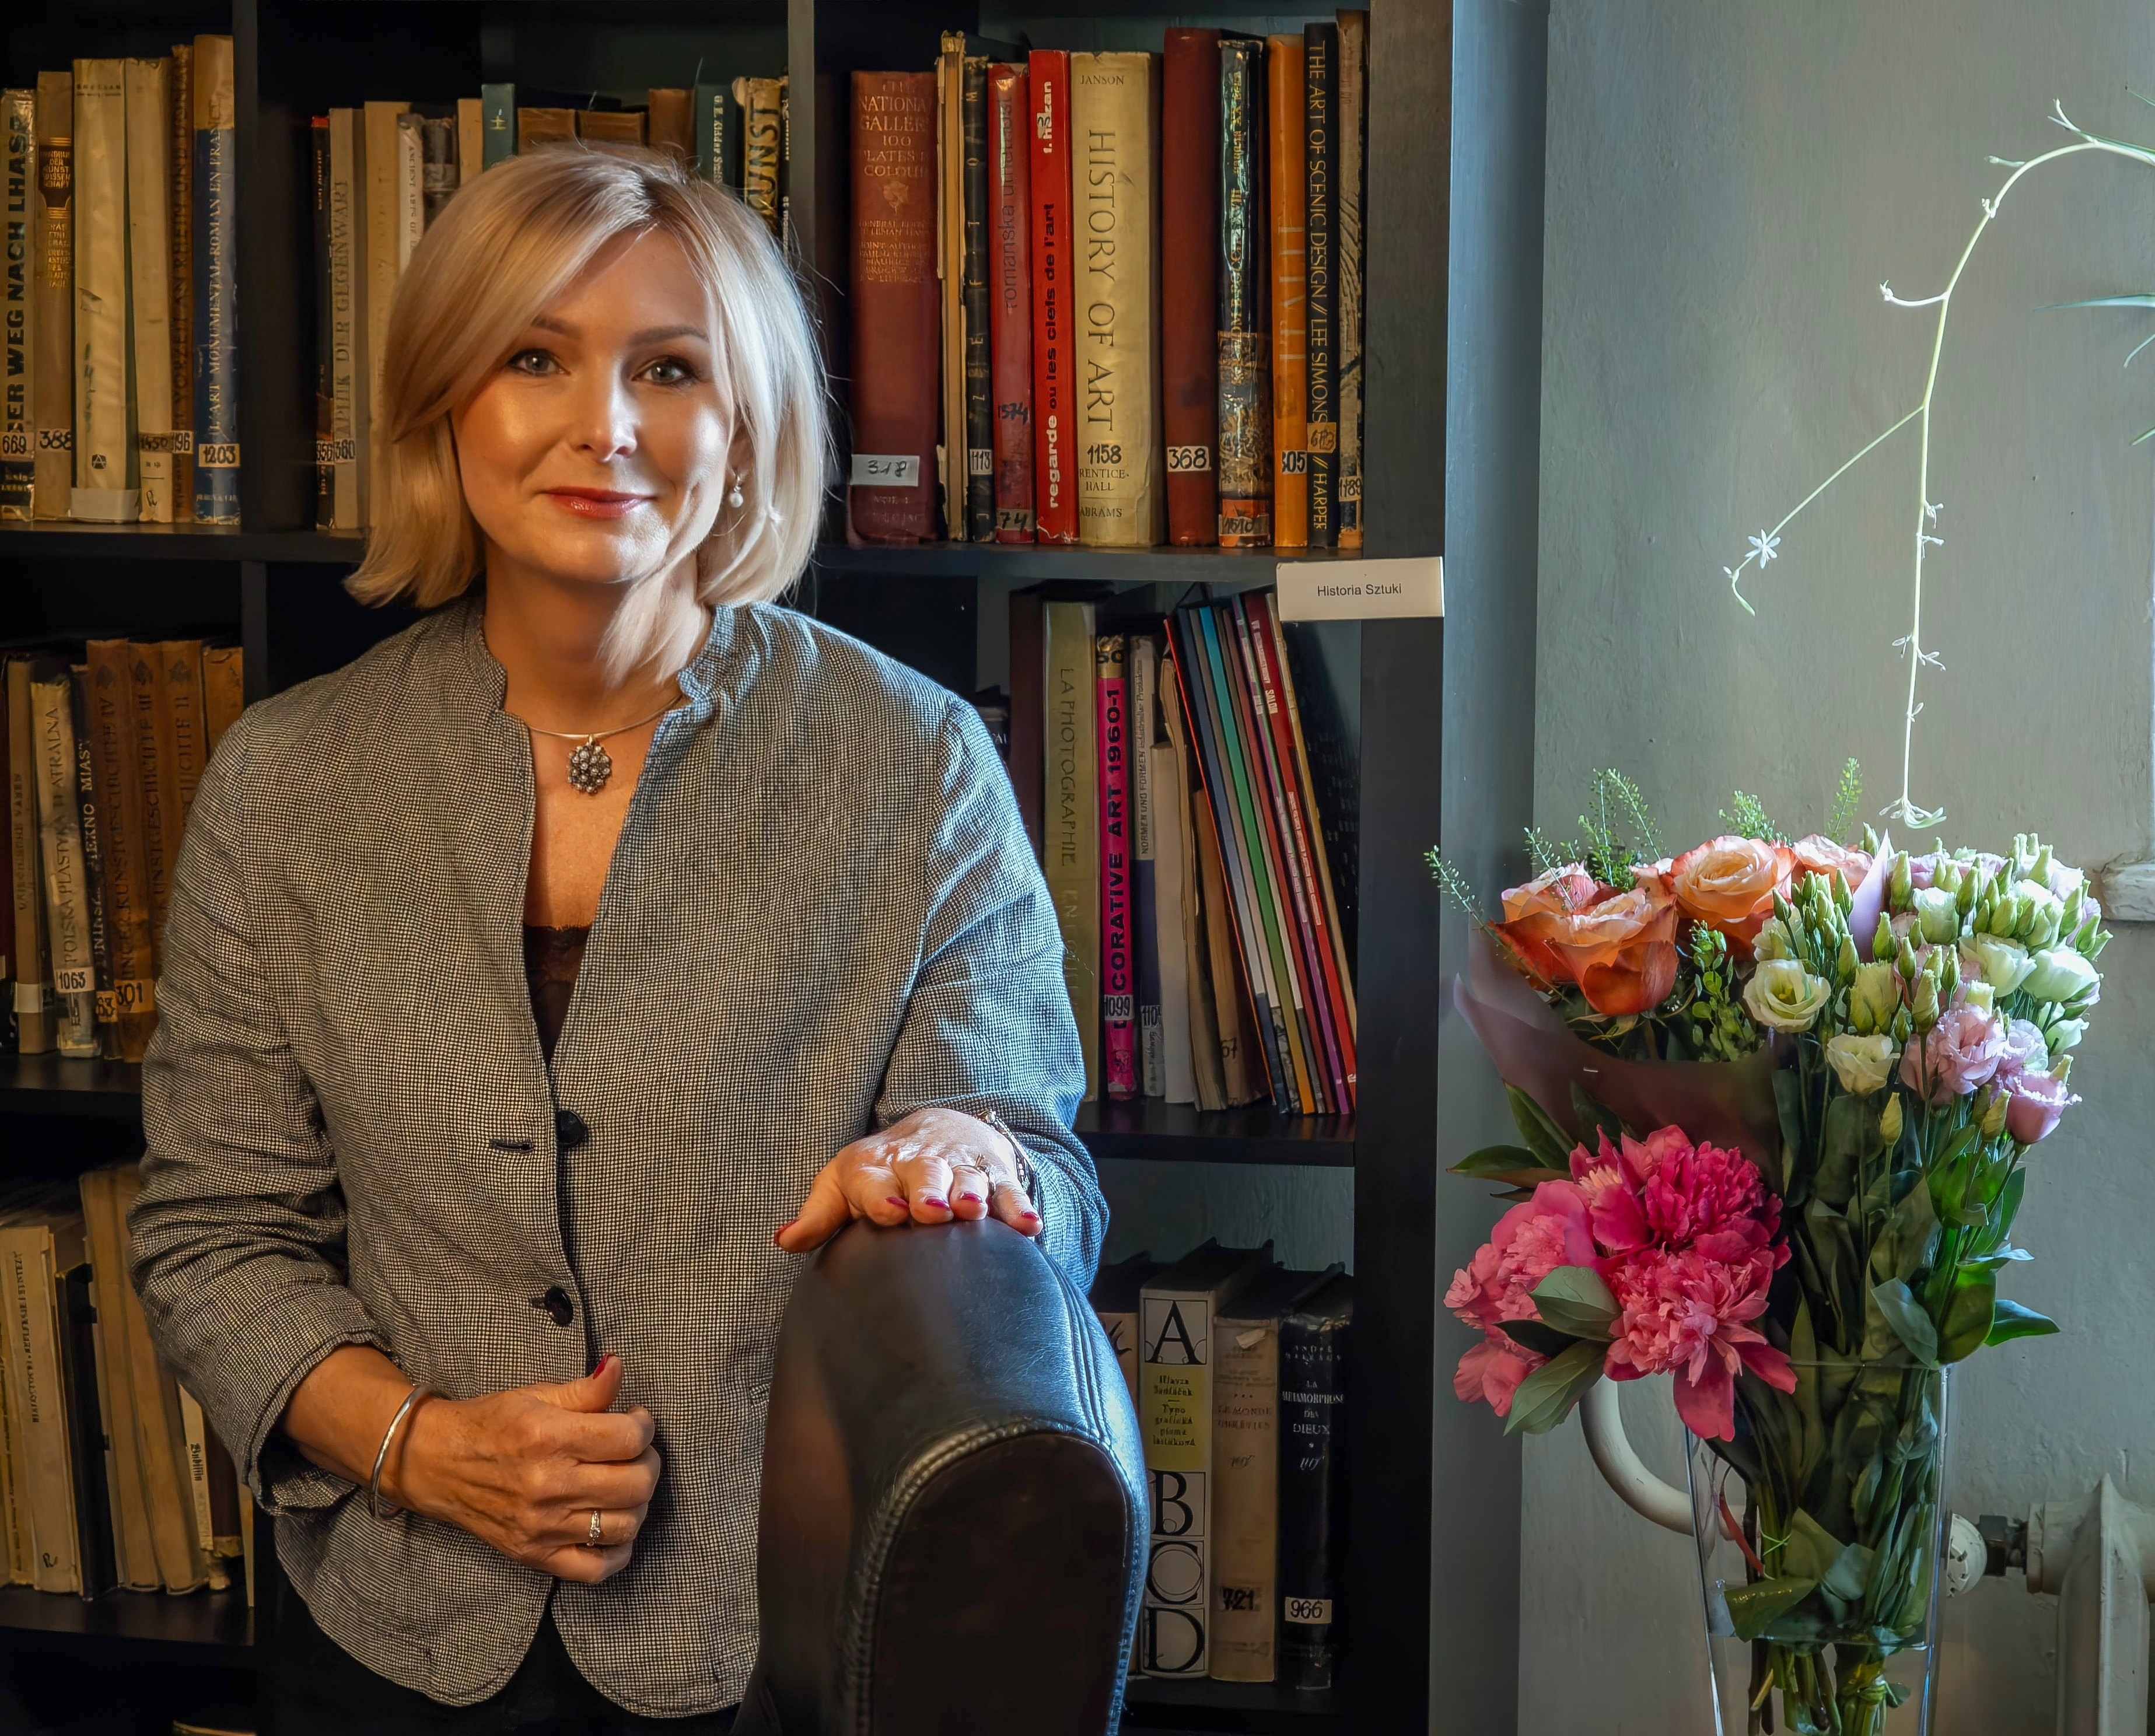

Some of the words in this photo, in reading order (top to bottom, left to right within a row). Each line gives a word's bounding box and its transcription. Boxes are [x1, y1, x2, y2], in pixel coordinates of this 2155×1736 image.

[1081, 75, 1125, 85] JANSON
[1309, 40, 1325, 80] THE
[1309, 84, 1325, 124] ART
[1309, 129, 1325, 155] OF
[1088, 130, 1116, 282] HISTORY
[1310, 159, 1326, 227] SCENIC
[1043, 203, 1055, 247] l'art
[8, 220, 26, 301] NACH
[1044, 254, 1055, 281] de
[1310, 231, 1327, 298] DESIGN
[8, 308, 25, 377] WEG
[1088, 303, 1115, 347] OF
[1311, 318, 1327, 347] LEE
[1046, 347, 1057, 380] les
[1048, 386, 1057, 410] ou
[1087, 359, 1115, 432] ART
[1311, 352, 1327, 424] SIMONS
[2, 435, 27, 454] 669
[39, 430, 72, 450] 388
[1087, 444, 1122, 465] 1158
[1168, 448, 1207, 469] 368
[867, 460, 908, 478] 318
[1046, 415, 1061, 509] regarde
[1079, 468, 1130, 479] RENTICE-
[1086, 482, 1115, 491] HALL
[1317, 584, 1362, 597] Historia
[1366, 583, 1402, 595] Sztuki
[1061, 668, 1075, 695] LA
[1106, 690, 1121, 775] 1960-1
[1061, 700, 1076, 867] PHOTOGRAPHIE
[1139, 792, 1149, 813] UND
[1107, 785, 1122, 838] ART
[1139, 815, 1149, 855] NORMEN
[1107, 853, 1129, 1030] DCORATIVE
[59, 971, 86, 989] 1063
[1153, 1300, 1205, 1366] A
[1153, 1471, 1194, 1537] B
[1147, 1541, 1203, 1605] C
[1290, 1600, 1323, 1619] 966
[1147, 1608, 1205, 1672] D
